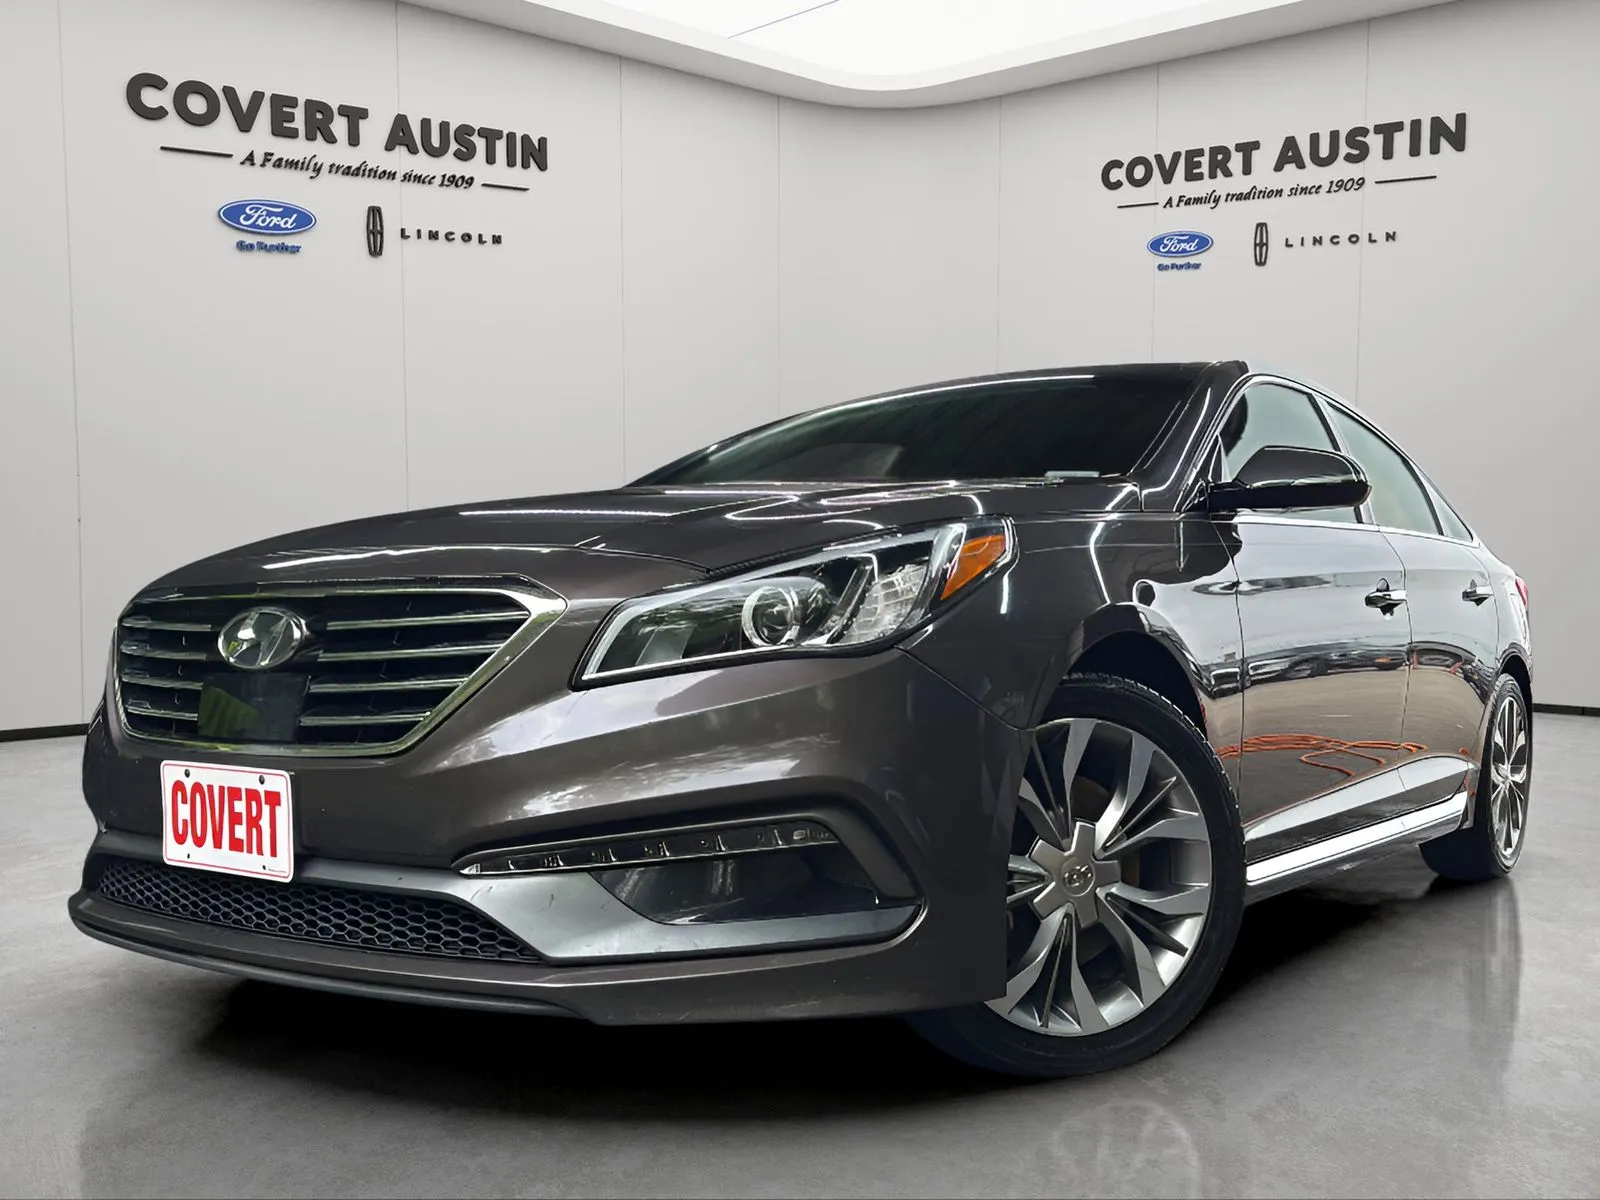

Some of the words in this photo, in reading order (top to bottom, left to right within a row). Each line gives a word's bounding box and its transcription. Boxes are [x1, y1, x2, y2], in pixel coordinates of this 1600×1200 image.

[125, 72, 368, 148] COVERT
[383, 113, 549, 173] AUSTIN
[1100, 140, 1261, 191] COVERT
[1272, 112, 1467, 173] AUSTIN
[239, 149, 257, 167] A
[259, 151, 324, 180] Family
[327, 160, 398, 182] tradition
[399, 169, 437, 186] since
[437, 173, 475, 190] 1909
[1162, 195, 1174, 209] A
[1175, 189, 1222, 210] Family
[1224, 184, 1284, 203] tradition
[1286, 183, 1323, 198] since
[1325, 176, 1366, 194] 1909
[239, 204, 298, 229] Ford
[400, 227, 503, 246] LINCOLN
[1159, 235, 1199, 252] Ford
[1284, 230, 1397, 249] LINCOLN
[171, 780, 282, 858] COVERT
